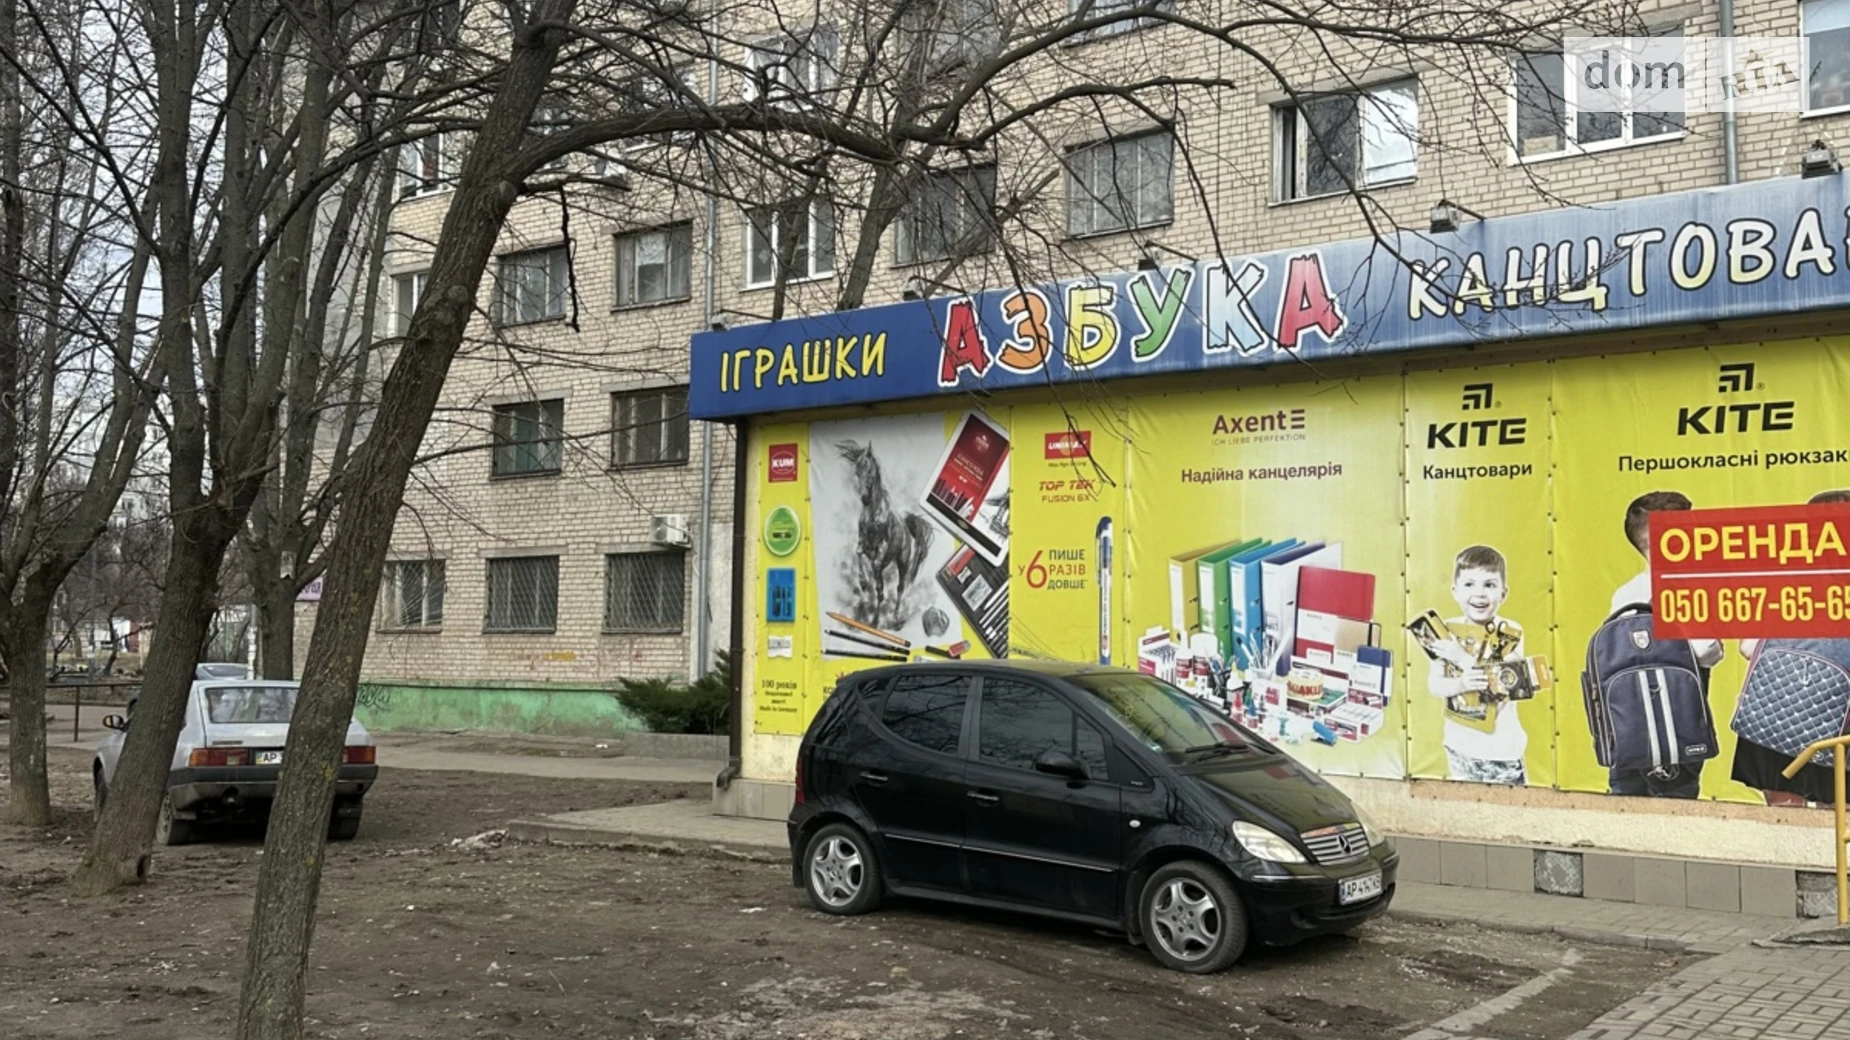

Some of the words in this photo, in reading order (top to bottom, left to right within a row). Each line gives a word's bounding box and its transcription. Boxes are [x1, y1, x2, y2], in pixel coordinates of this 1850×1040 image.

[720, 331, 888, 392] ІГРАШКИ
[938, 252, 1345, 386] АЗБУКА
[1407, 207, 1850, 321] КАНЦТОВА
[1212, 410, 1287, 435] Axent
[1677, 401, 1795, 436] KITE
[1212, 439, 1226, 447] ICH
[1228, 437, 1251, 446] LIEBE
[1253, 433, 1306, 443] PERFEKTION
[1427, 418, 1527, 449] KITE
[772, 458, 795, 468] KUM
[1423, 464, 1532, 480] Канцтовари
[1618, 450, 1759, 474] Першокласні
[1765, 450, 1850, 470] рюкзак
[1181, 467, 1244, 485] Надійна
[1248, 461, 1343, 480] канцелярія
[1039, 480, 1065, 492] TOP
[1041, 494, 1075, 503] FUSION
[1659, 521, 1847, 565] ОРЕНДА
[1049, 549, 1086, 561] ПИШЕ
[1026, 550, 1048, 589] 6
[1049, 564, 1086, 576] РАЗІВ
[1047, 579, 1086, 590] ДОВШЕ
[1660, 588, 1708, 623] 050
[762, 680, 774, 689] 100
[776, 681, 798, 690] років
[263, 752, 277, 762] AP
